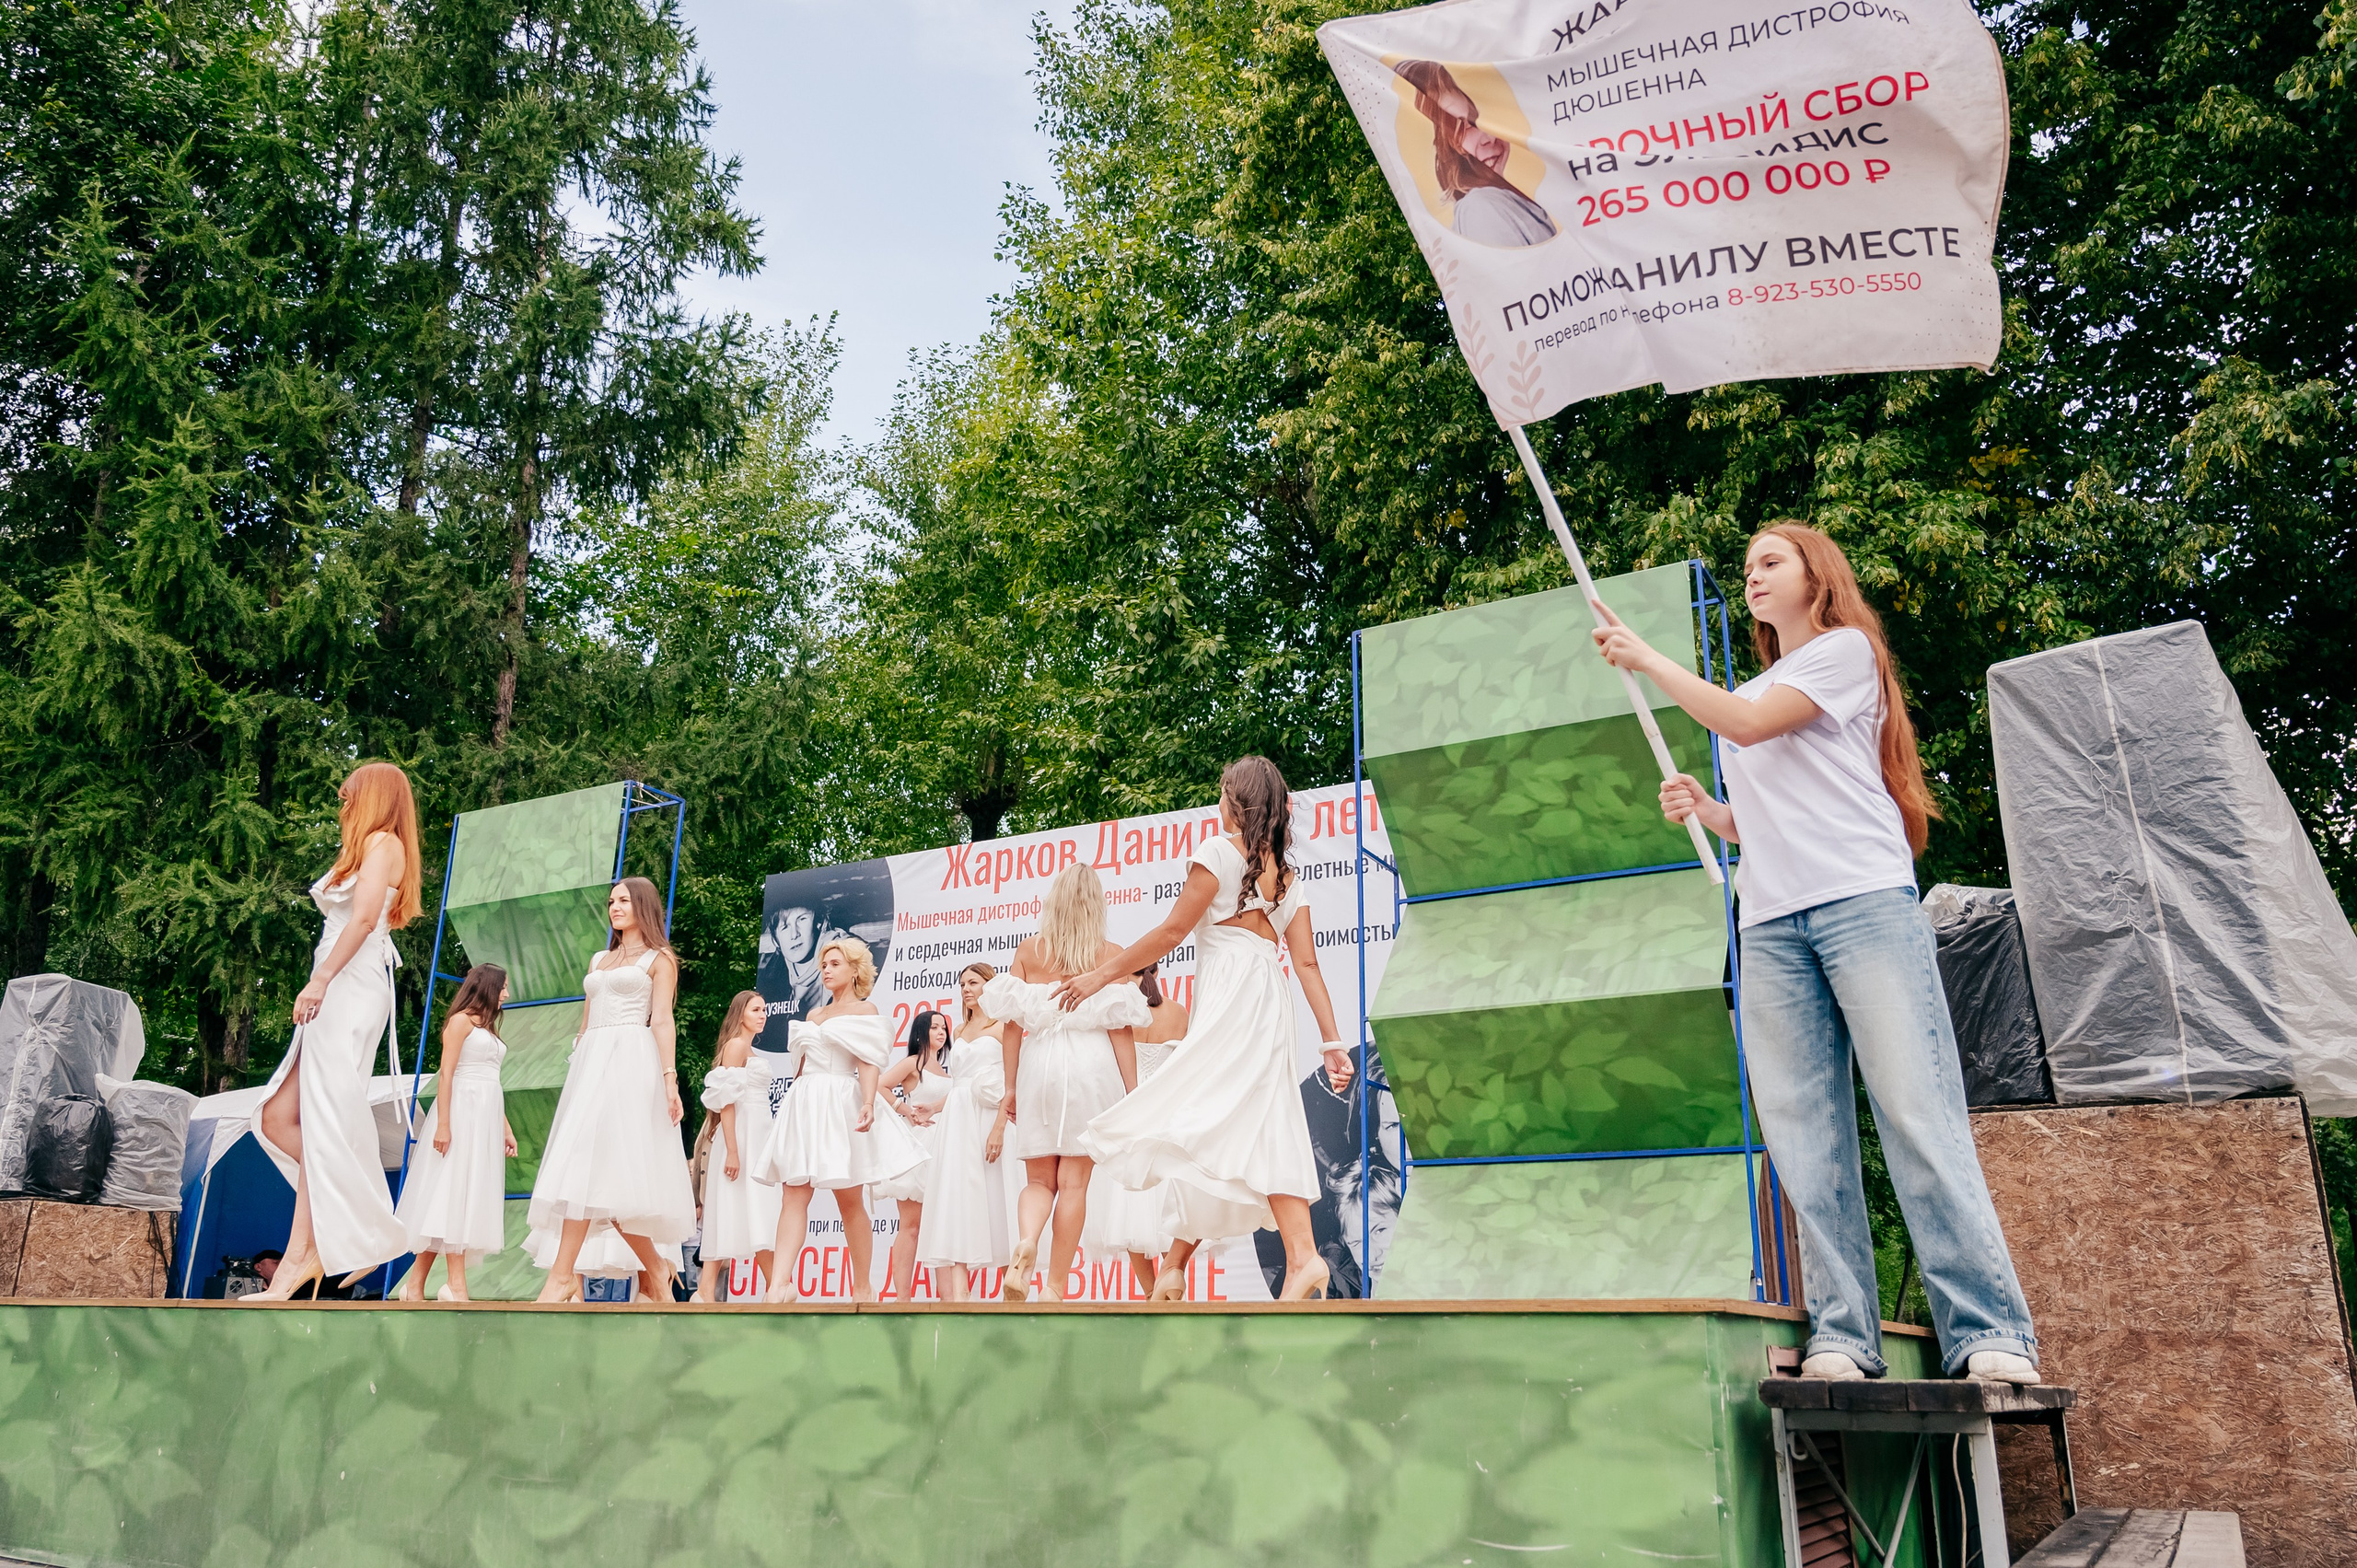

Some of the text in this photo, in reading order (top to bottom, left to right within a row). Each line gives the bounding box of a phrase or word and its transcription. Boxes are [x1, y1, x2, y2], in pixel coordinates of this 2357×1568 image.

[1548, 1, 1910, 92] МЫШЕЧНАЯ ДИСТРОФИЯ
[1553, 68, 1707, 125] ДЮШЕННА
[1573, 72, 1930, 155] ОЧНЫЙ СБОР
[1568, 153, 1619, 180] на
[1576, 185, 1649, 227] 265
[1663, 171, 1749, 207] 000
[1765, 160, 1850, 195] 000
[1502, 226, 1961, 332] ПОМОЖ АНИЛУ ВМЕСТЕ
[1534, 316, 1598, 353] перевод
[1599, 308, 1618, 326] по
[1728, 272, 1922, 306] 8-923-530-5550
[897, 907, 974, 932] Мышечная
[977, 894, 1042, 925] дистроф
[895, 947, 904, 962] и
[908, 937, 983, 964] сердечная
[893, 969, 961, 991] Необходи
[808, 1219, 830, 1237] при
